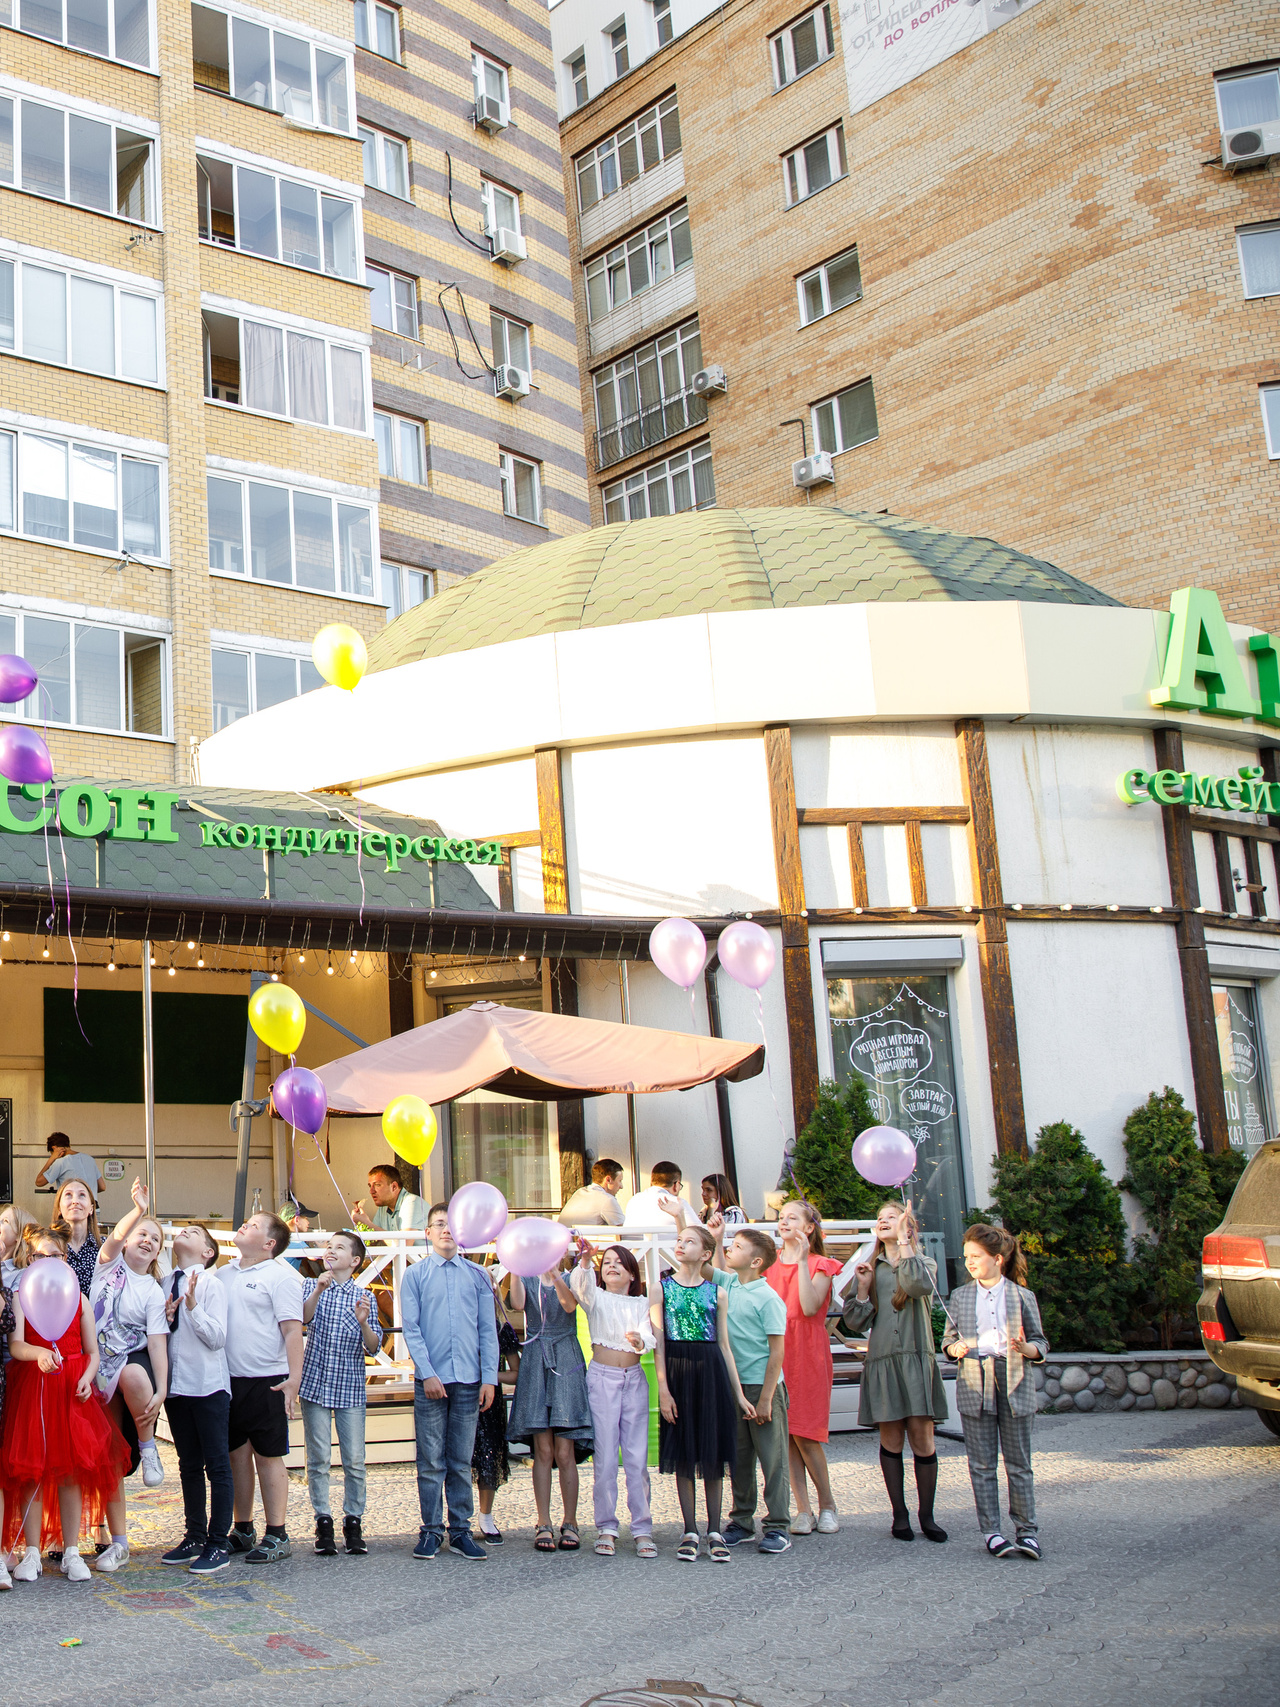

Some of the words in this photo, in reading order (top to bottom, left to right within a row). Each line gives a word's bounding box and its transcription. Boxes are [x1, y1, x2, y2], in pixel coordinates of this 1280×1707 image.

[883, 28, 904, 50] ДО
[1116, 765, 1280, 817] семей
[199, 821, 505, 873] кондитерская
[855, 1036, 888, 1056] УЮТНАЯ
[888, 1033, 925, 1046] ИГРОВАЯ
[869, 1052, 878, 1063] С
[874, 1058, 919, 1075] АНИМАТОРОМ
[909, 1089, 946, 1103] ЗАВТРАК
[908, 1100, 930, 1112] ЦЕЛЫЙ
[930, 1103, 946, 1117] ДЕНЬ
